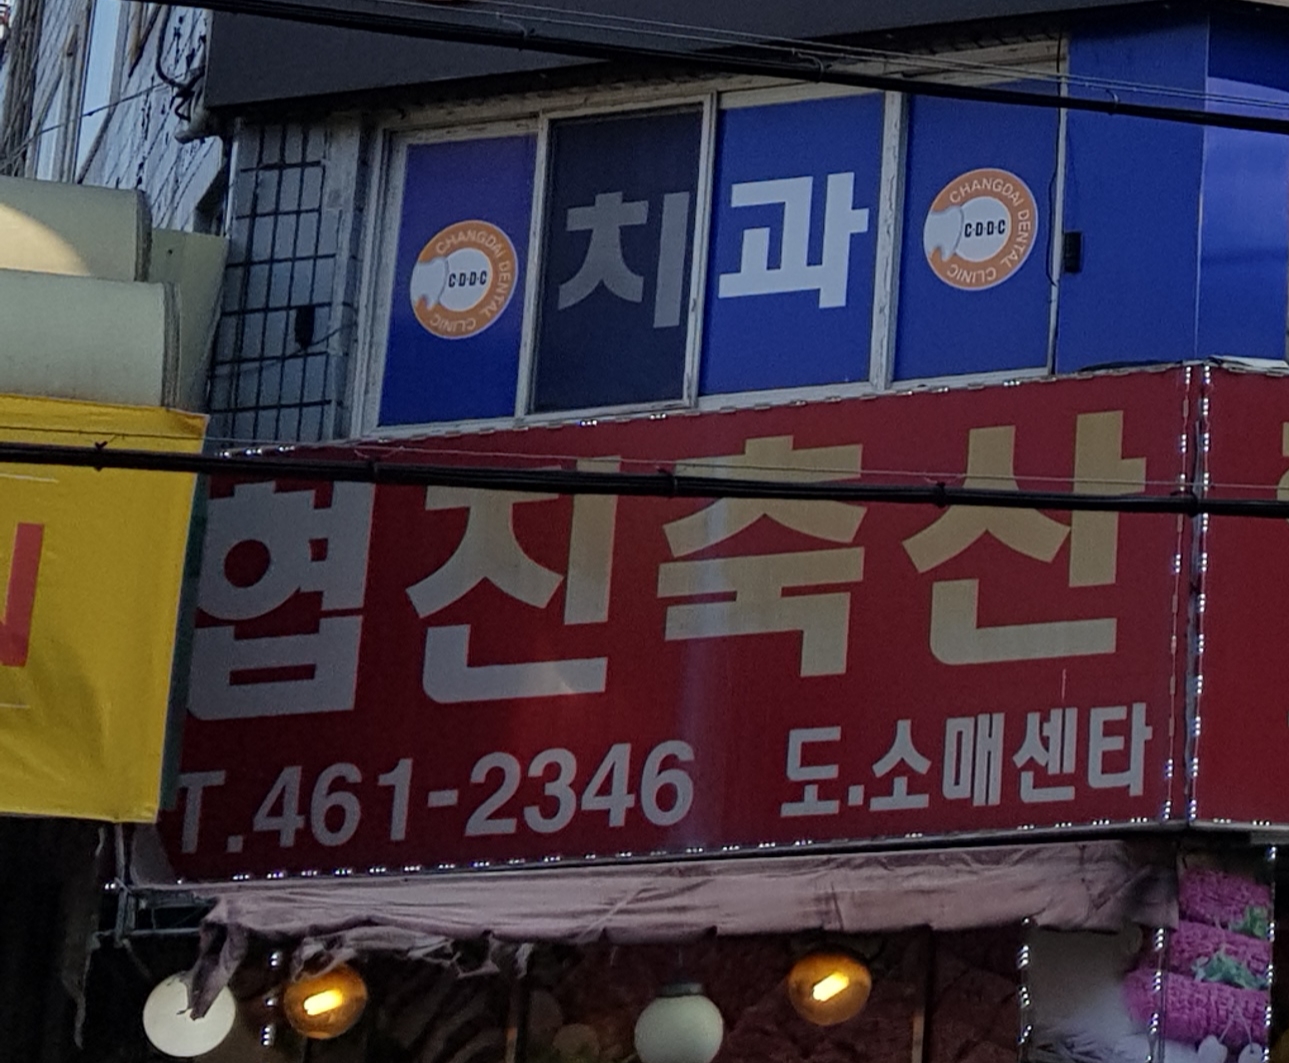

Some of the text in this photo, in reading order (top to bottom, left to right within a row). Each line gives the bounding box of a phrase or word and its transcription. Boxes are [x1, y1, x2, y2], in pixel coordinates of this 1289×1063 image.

[559, 172, 869, 328] 치과
[947, 177, 1031, 283] CHANGDAI DENTAL CLINIC
[188, 410, 1147, 721] 협진축산
[781, 703, 1153, 817] 도.소매센타
